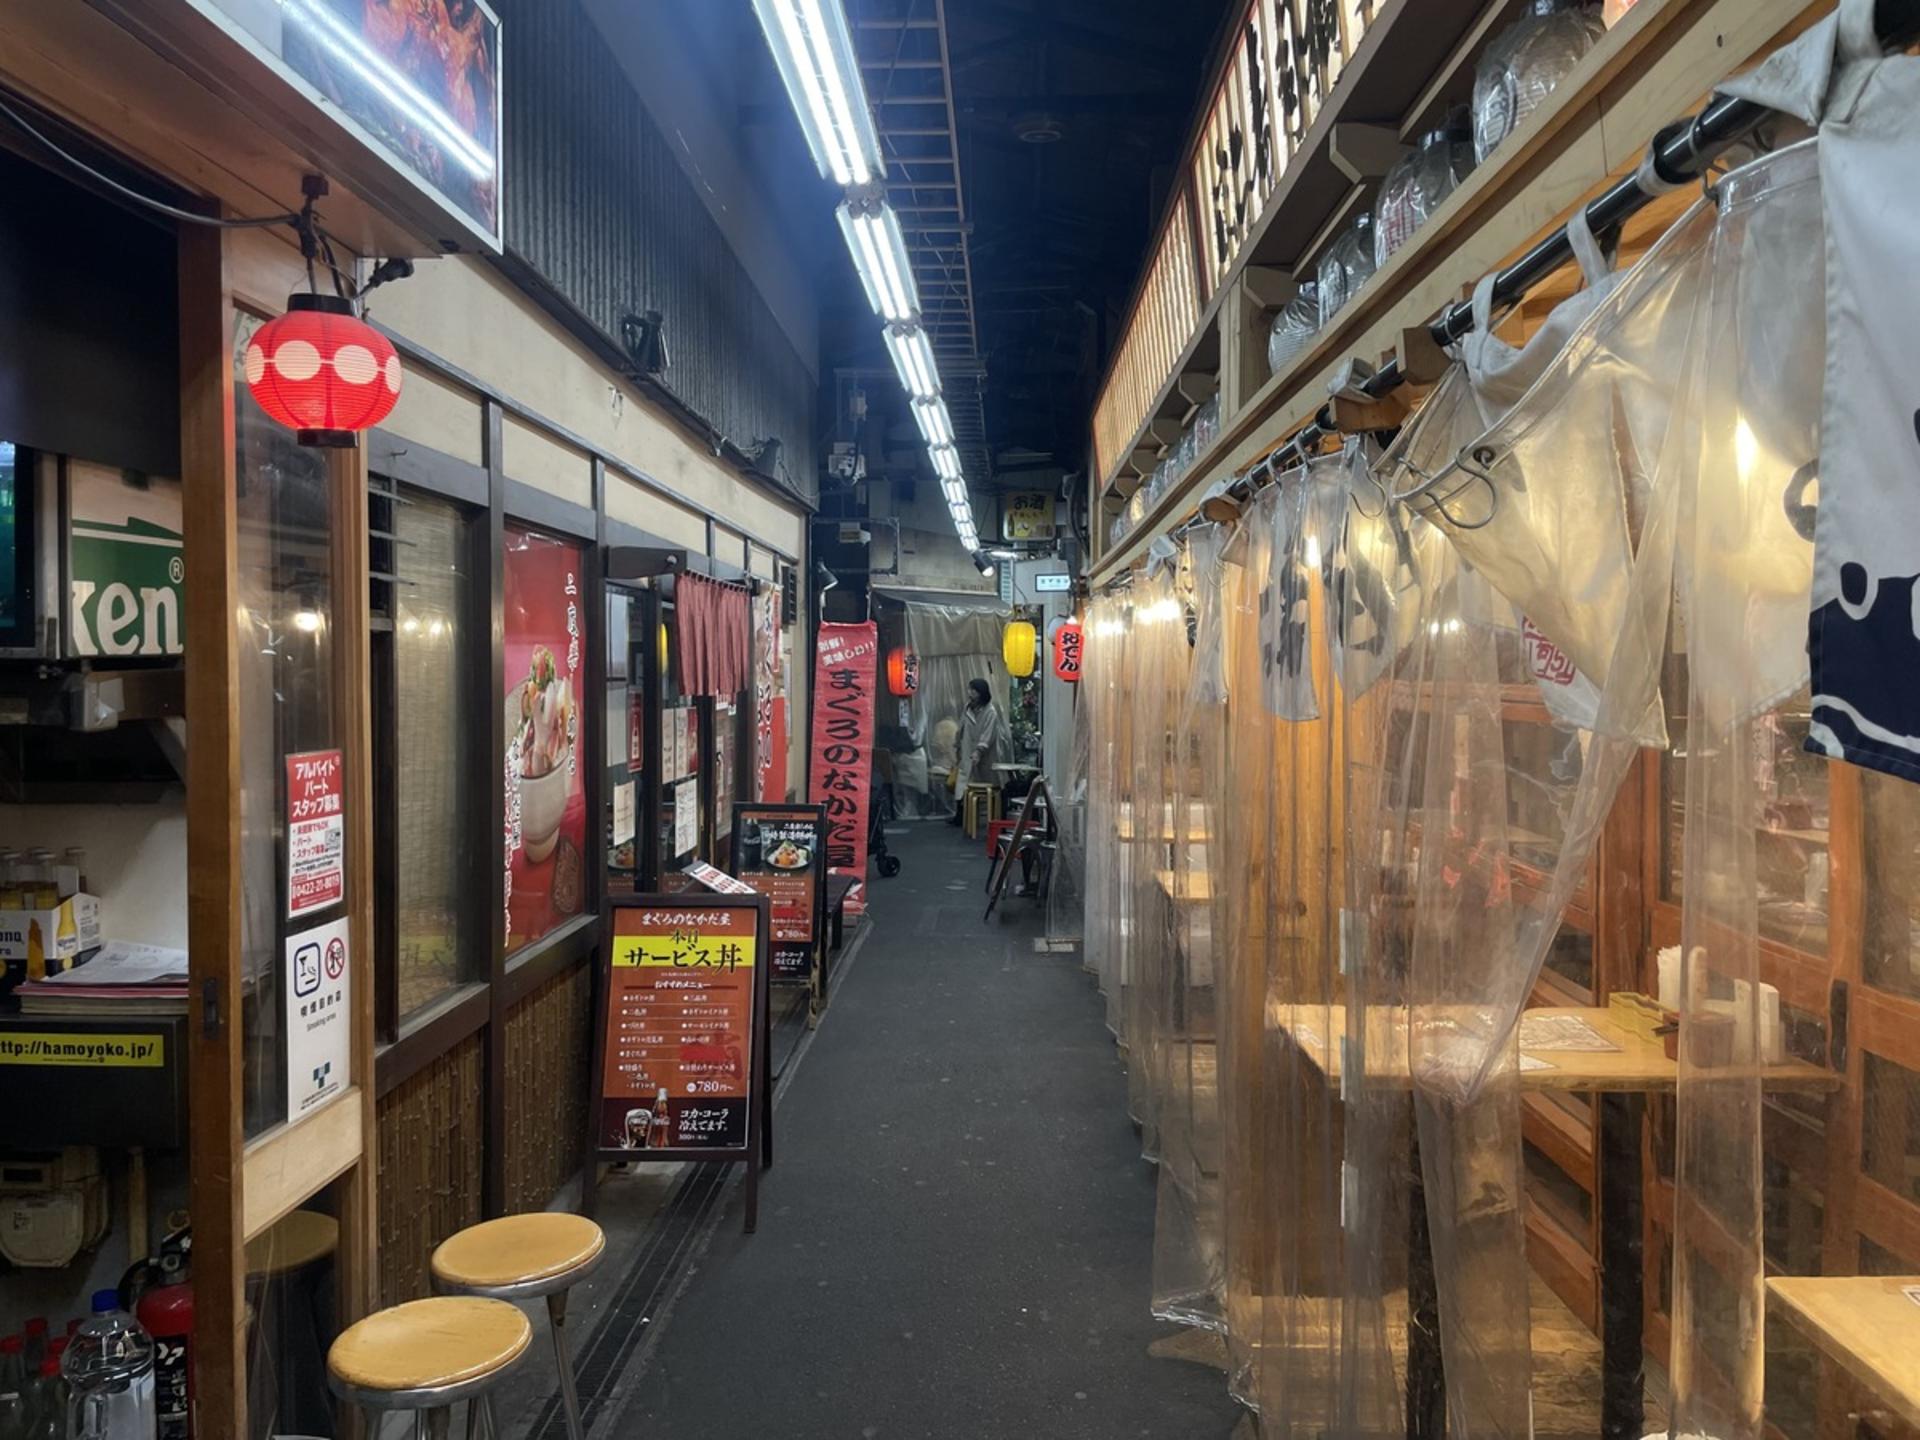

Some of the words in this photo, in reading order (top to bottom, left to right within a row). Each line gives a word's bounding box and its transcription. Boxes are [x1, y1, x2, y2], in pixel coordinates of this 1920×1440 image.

[295, 759, 336, 780] アルバイト
[305, 777, 329, 796] パート
[292, 793, 340, 817] スタッフ募集
[642, 912, 732, 926] まぐろのなかだ屋
[671, 928, 699, 944] 本日
[624, 944, 743, 975] サービス丼
[654, 980, 711, 990] おすすめメニュー
[680, 1108, 729, 1120] コカ・コーラ
[678, 1120, 728, 1131] 冷えてます。
